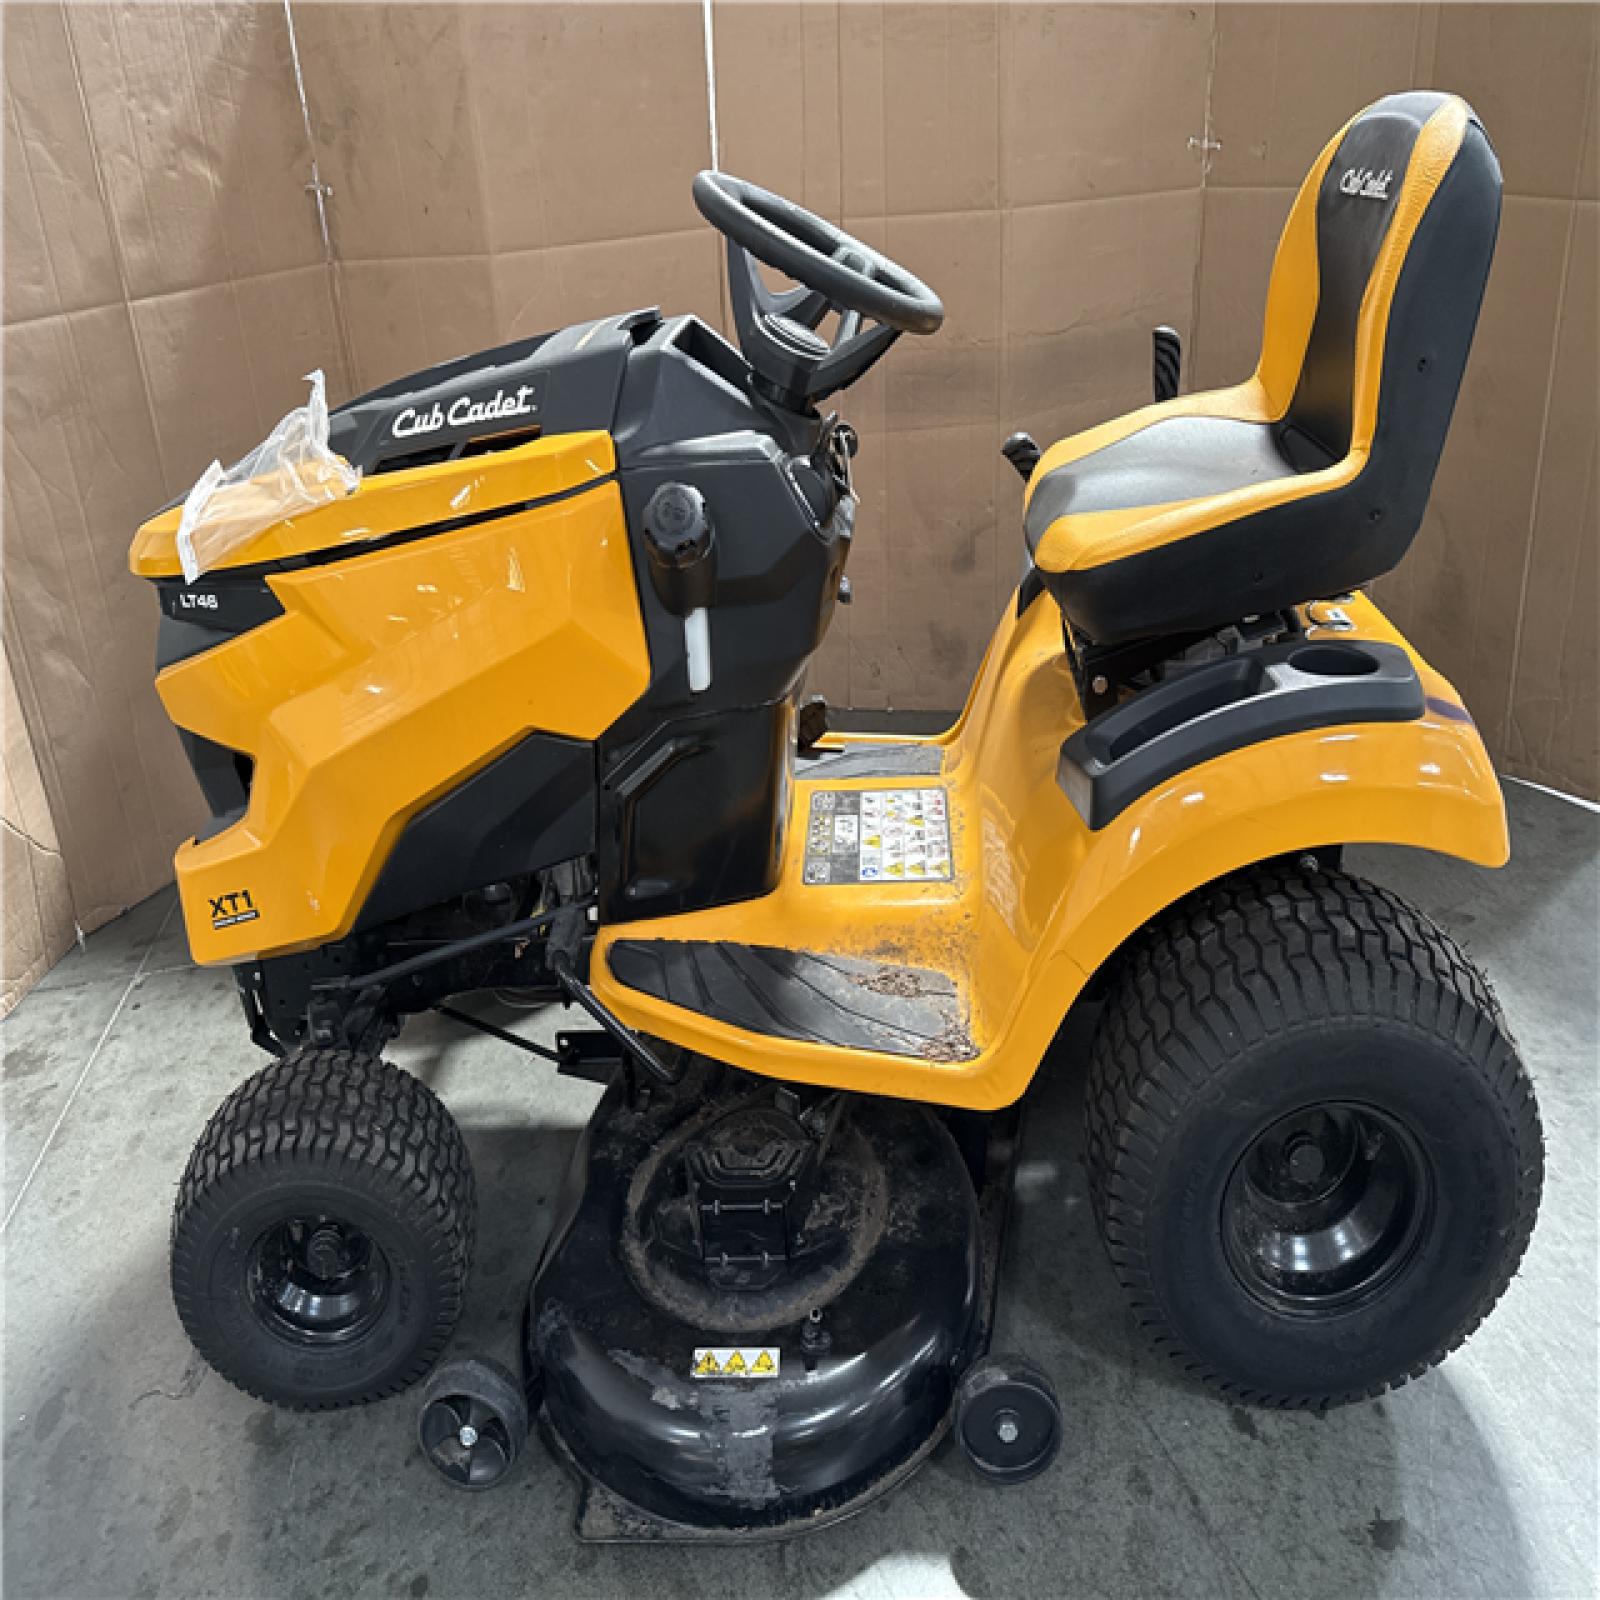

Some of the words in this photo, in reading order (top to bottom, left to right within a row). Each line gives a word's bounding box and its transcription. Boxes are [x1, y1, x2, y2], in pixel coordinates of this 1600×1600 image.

[392, 402, 444, 437] Cub
[447, 385, 535, 425] Cadet
[208, 889, 253, 918] XT1
